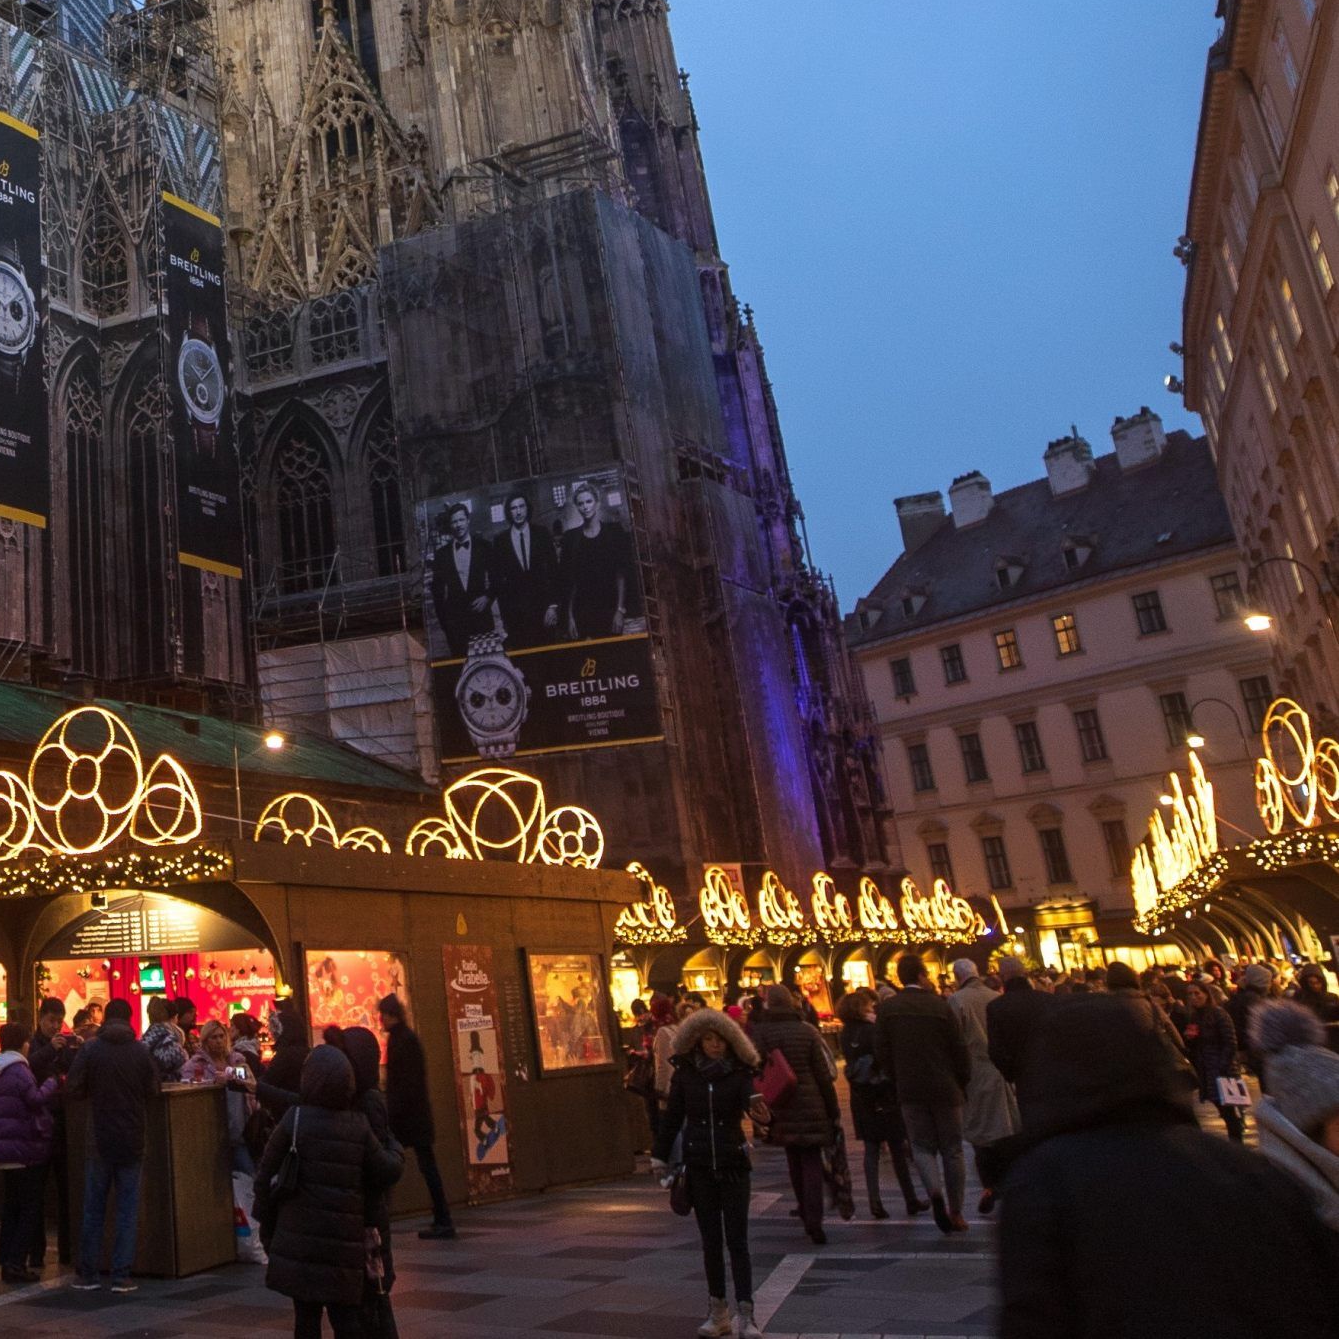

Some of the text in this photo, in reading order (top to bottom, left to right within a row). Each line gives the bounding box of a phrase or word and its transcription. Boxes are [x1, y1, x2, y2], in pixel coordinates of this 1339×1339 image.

[170, 254, 221, 286] BREITLING
[545, 674, 640, 697] BREITLING
[580, 695, 607, 707] 1884
[462, 960, 477, 971] Radio
[458, 969, 490, 985] Arabella
